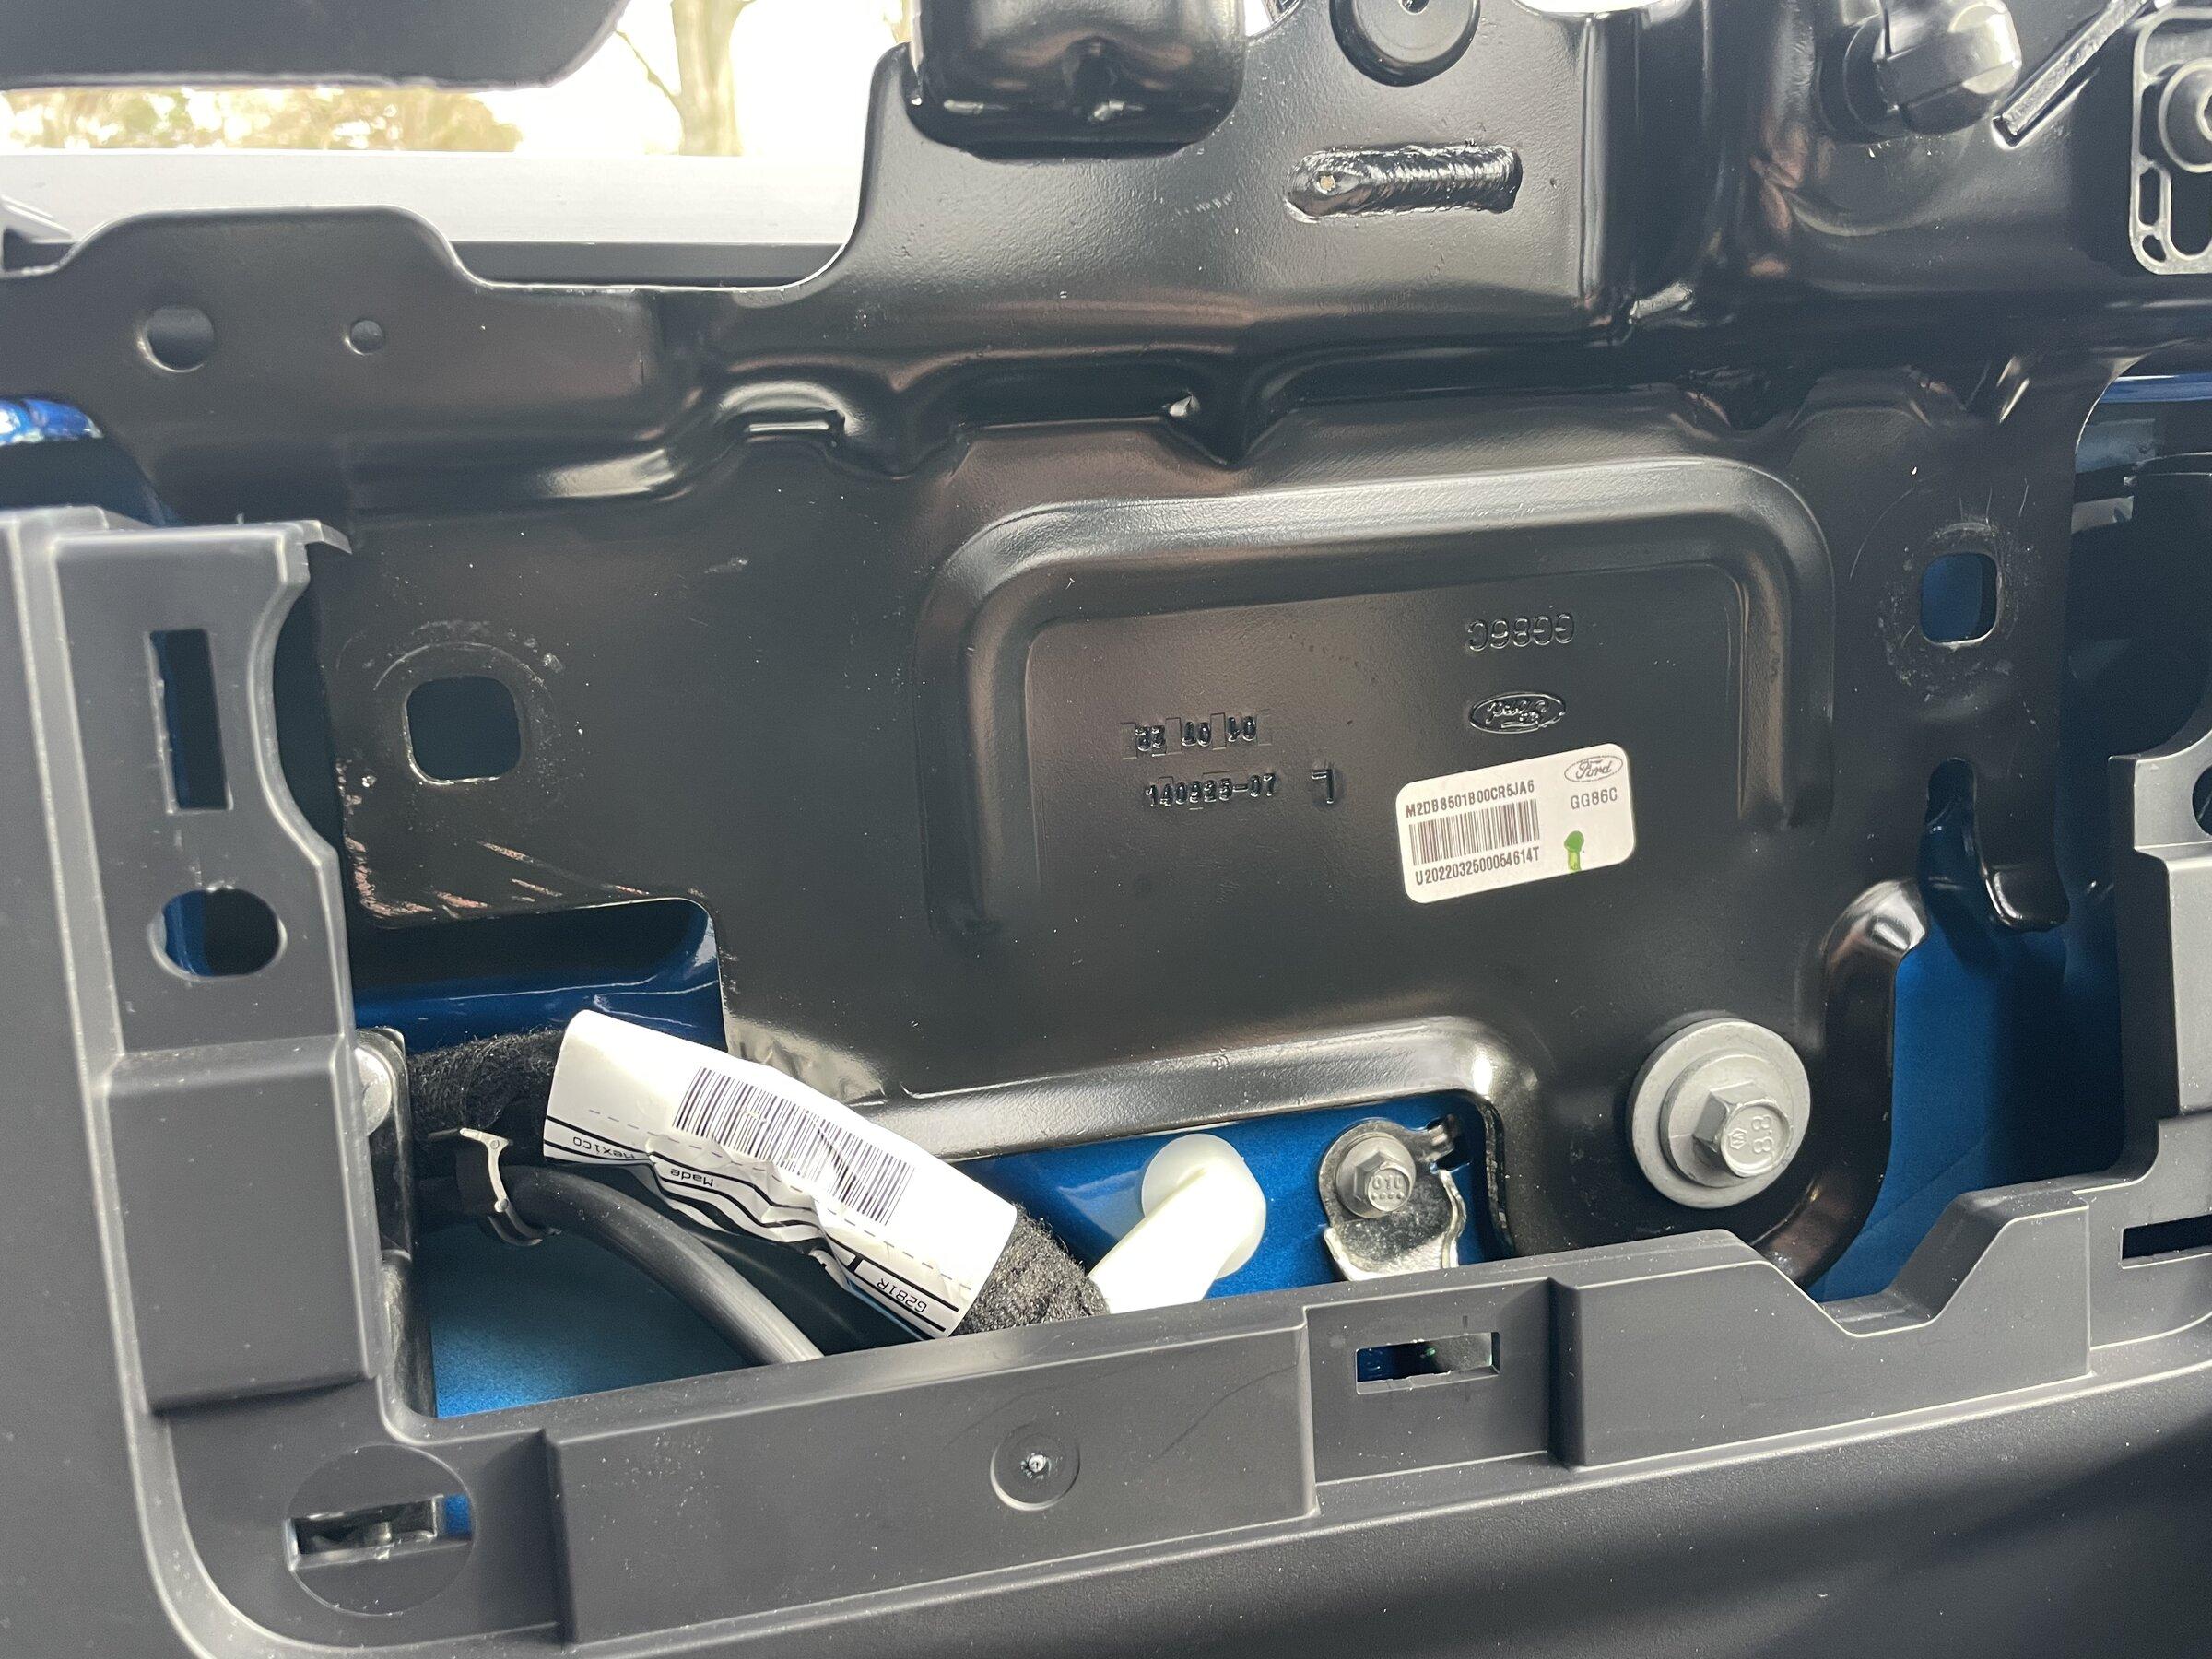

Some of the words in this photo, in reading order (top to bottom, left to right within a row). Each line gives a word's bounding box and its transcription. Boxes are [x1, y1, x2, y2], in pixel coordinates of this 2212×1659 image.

[1467, 613, 1575, 652] GG86C
[1575, 759, 1613, 780] Ford
[1571, 787, 1618, 810] GG86C
[670, 1168, 713, 1188] Made
[877, 1278, 927, 1313] G281R
